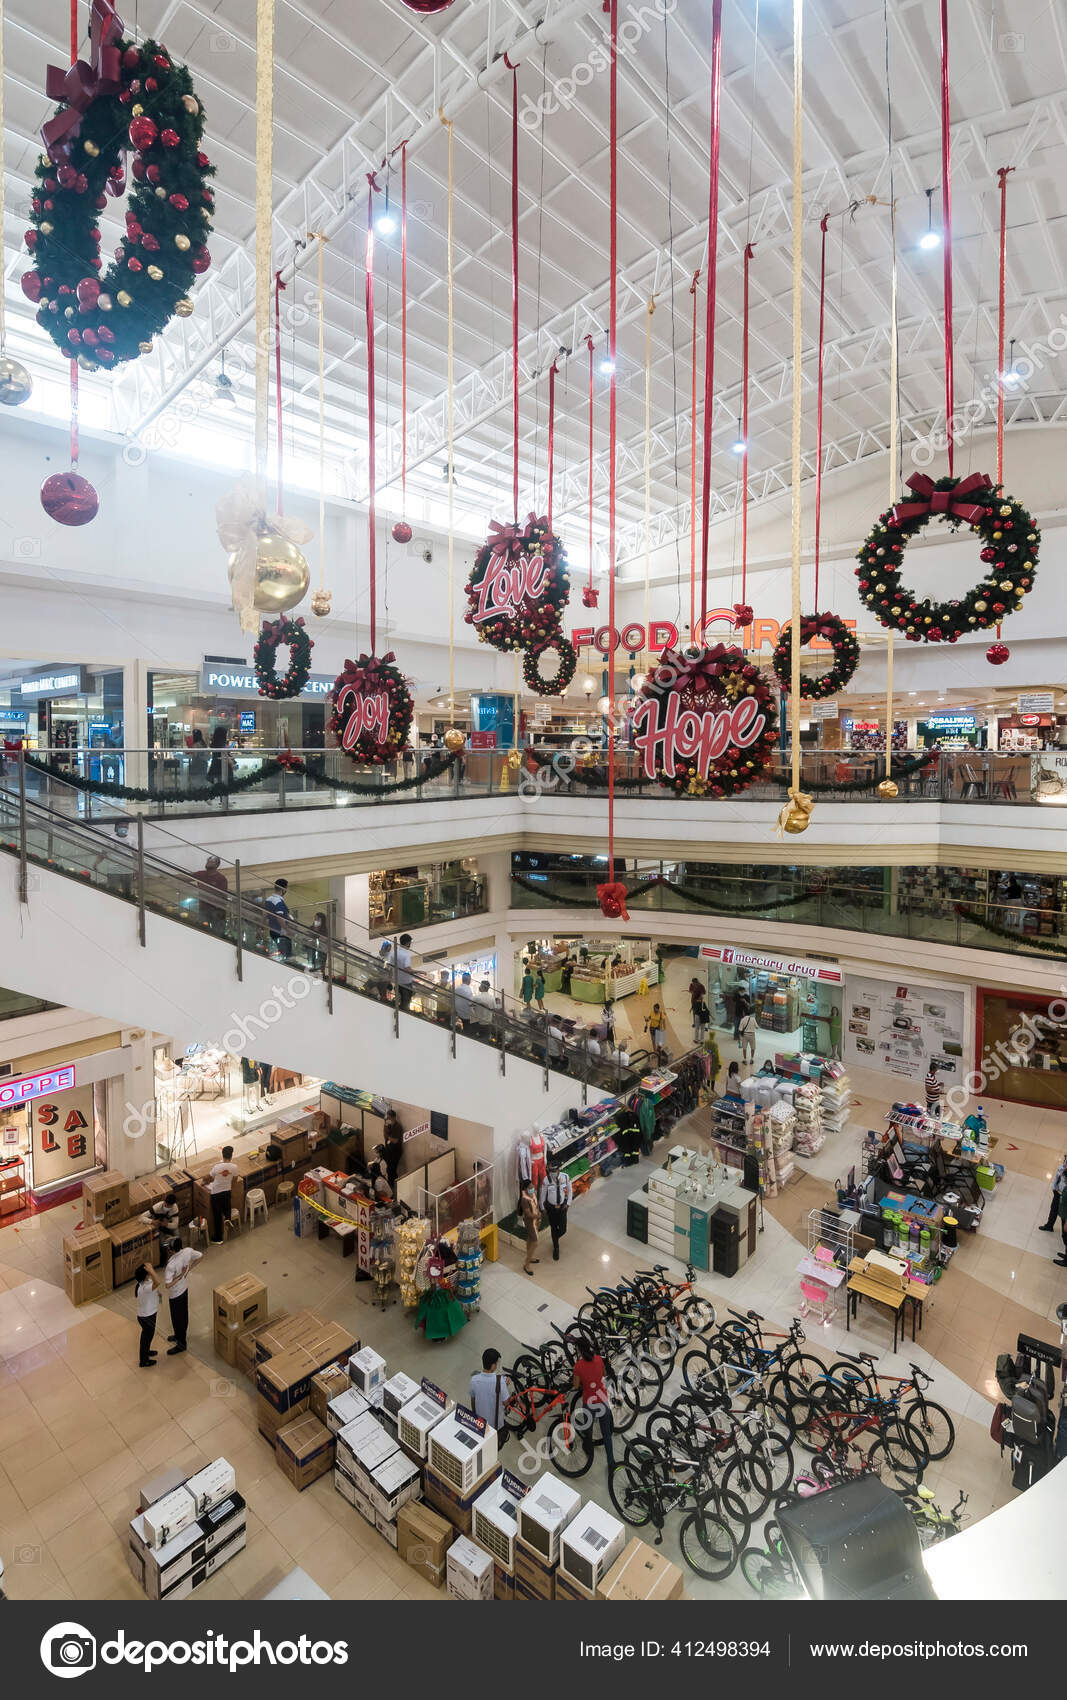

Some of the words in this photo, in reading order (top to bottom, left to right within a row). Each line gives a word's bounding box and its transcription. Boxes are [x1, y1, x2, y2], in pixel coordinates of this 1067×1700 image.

[472, 549, 550, 623] Love
[572, 620, 678, 655] FOOD
[337, 683, 391, 750] Joy
[633, 691, 766, 779] Hope
[735, 953, 783, 970] mercury
[787, 962, 816, 977] drug
[0, 1072, 70, 1102] OPPE
[403, 1123, 430, 1141] CASHIER
[456, 1408, 485, 1429] FUJIDENZO
